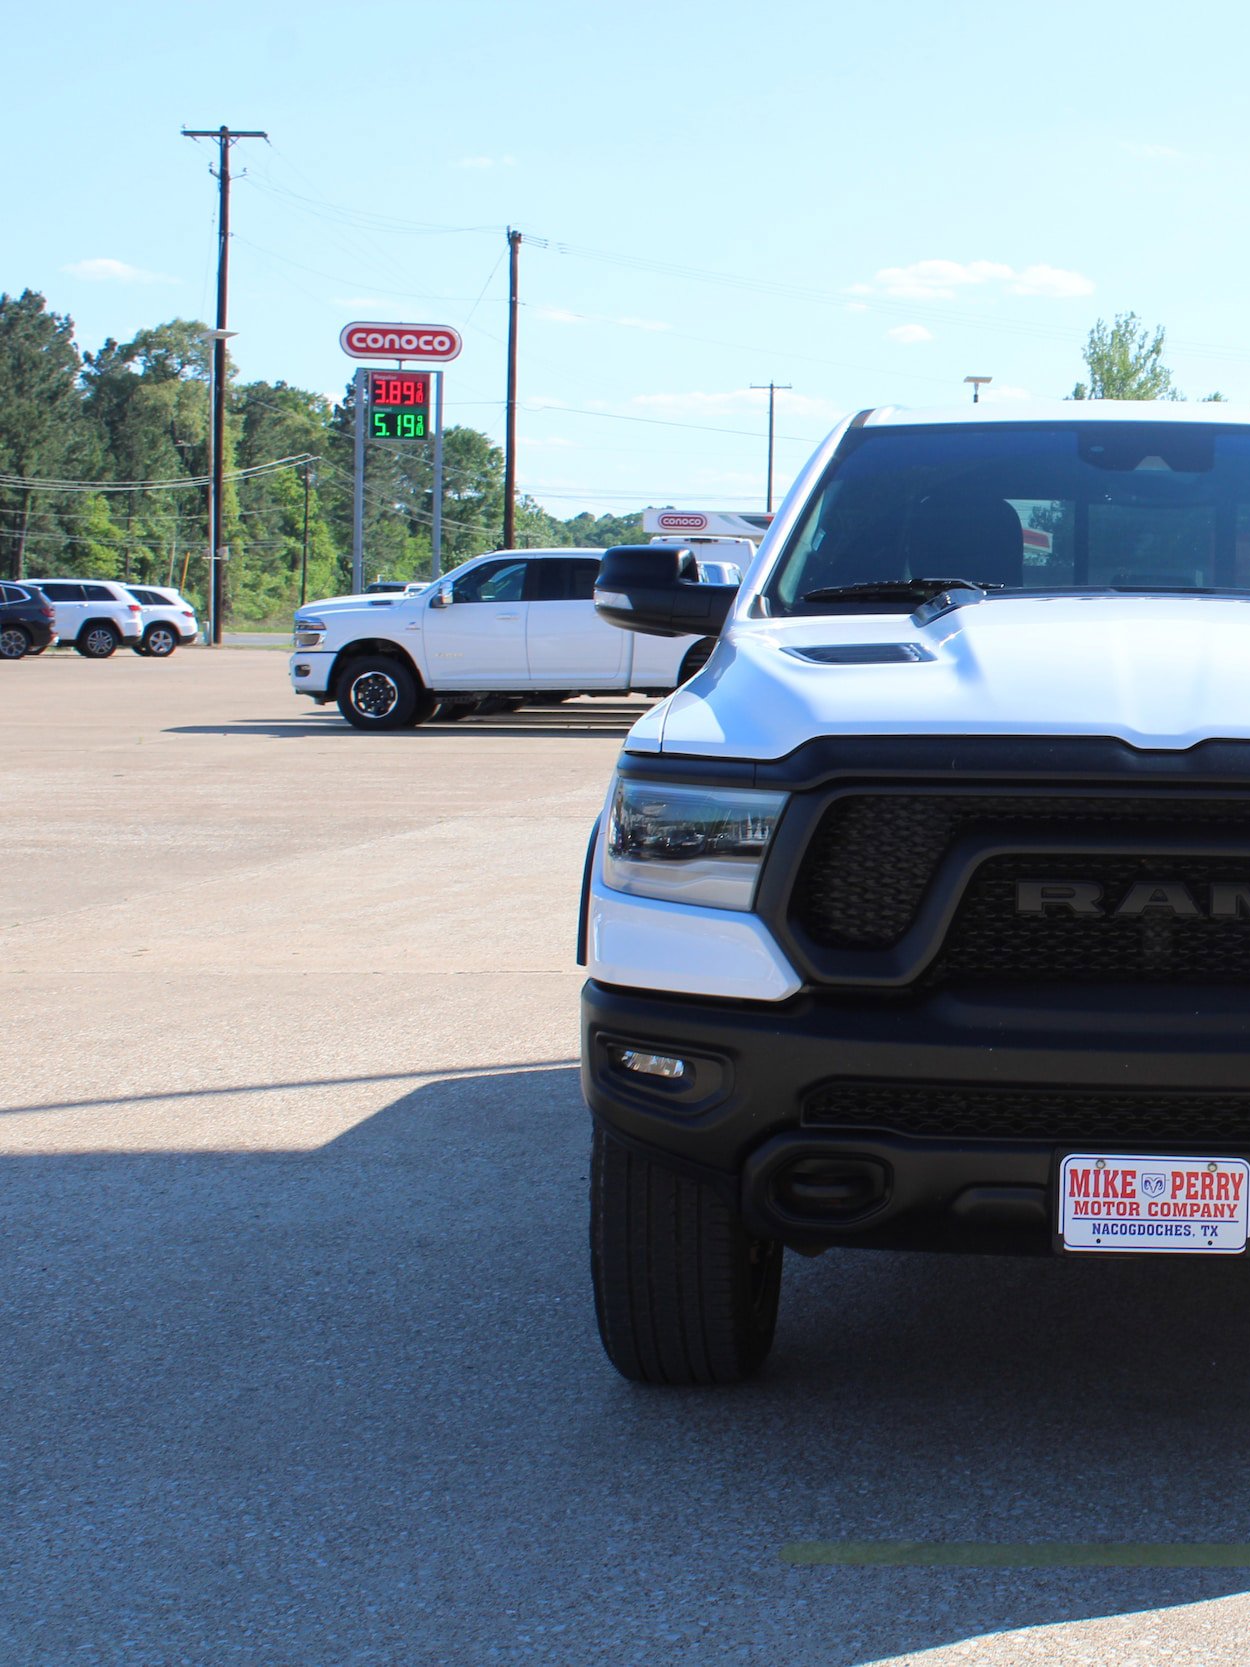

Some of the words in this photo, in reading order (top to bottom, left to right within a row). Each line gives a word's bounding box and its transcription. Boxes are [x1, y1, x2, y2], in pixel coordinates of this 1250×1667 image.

[375, 380, 415, 405] 3.89
[374, 413, 415, 437] 5.19
[1069, 1168, 1137, 1199] MIKE
[1170, 1171, 1244, 1201] PERRY
[1073, 1200, 1140, 1216] MOTOR
[1147, 1202, 1238, 1218] COMPANY
[1091, 1222, 1196, 1238] NACOGDOCHES,
[1200, 1224, 1219, 1237] TX
